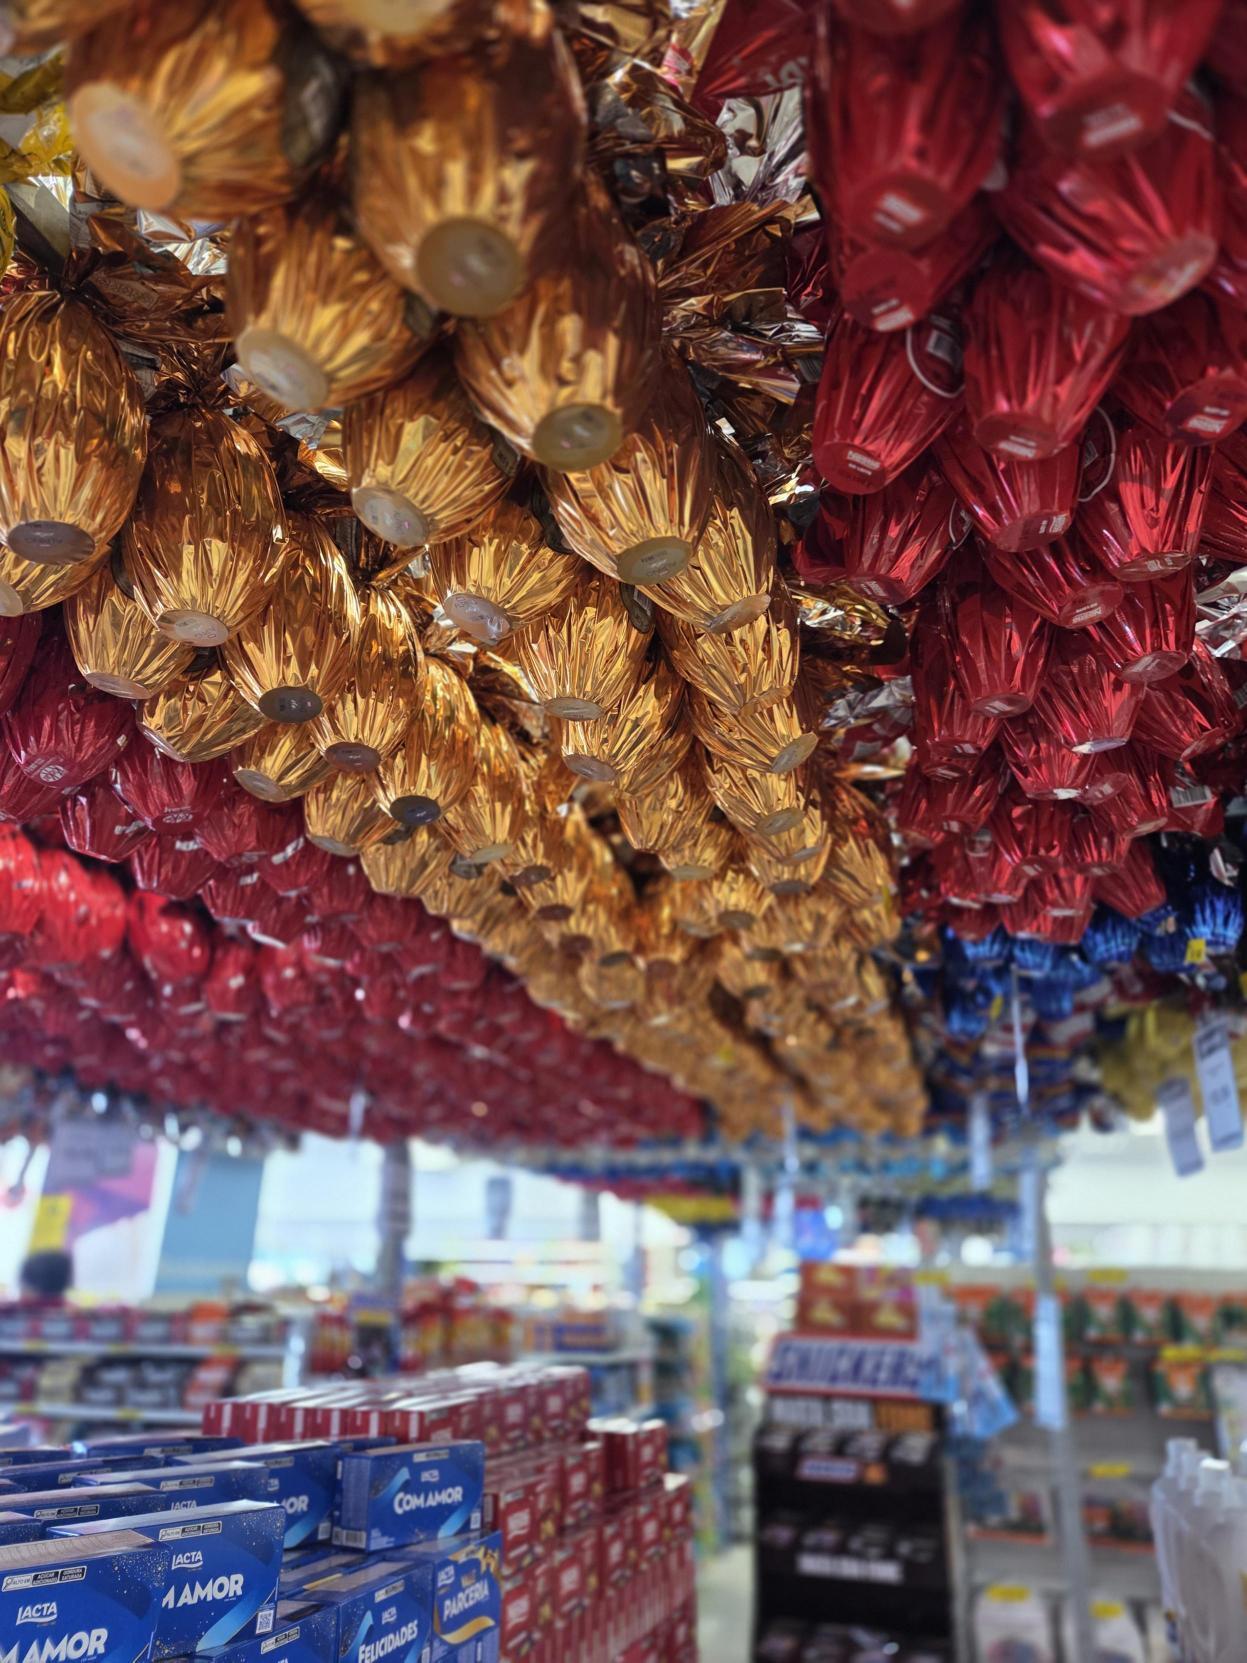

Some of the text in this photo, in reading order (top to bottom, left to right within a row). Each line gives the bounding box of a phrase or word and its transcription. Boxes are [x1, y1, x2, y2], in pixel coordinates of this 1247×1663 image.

[281, 1496, 309, 1514] OR
[393, 1486, 463, 1514] COM AMOR
[171, 1550, 203, 1570] LACTA
[176, 1574, 244, 1608] AMOR
[443, 1578, 489, 1622] PARCERIA
[16, 1602, 57, 1626] LACTA
[22, 1628, 108, 1663] AMOR
[358, 1619, 418, 1663] FELICIDADES
